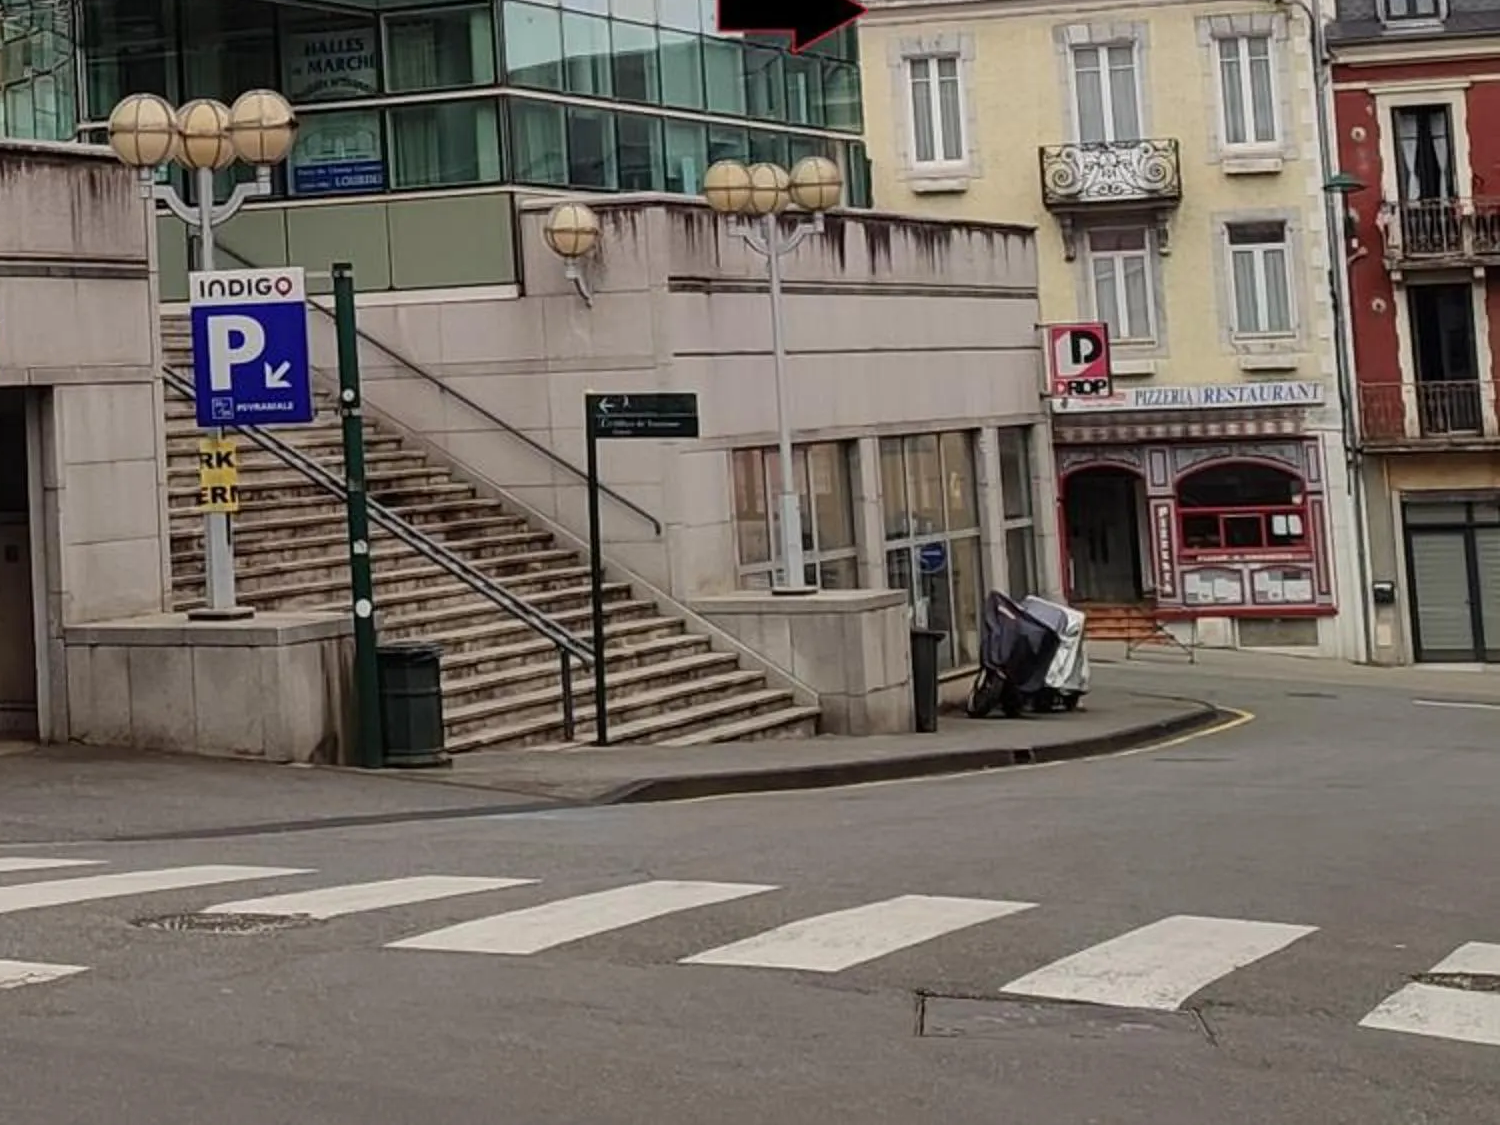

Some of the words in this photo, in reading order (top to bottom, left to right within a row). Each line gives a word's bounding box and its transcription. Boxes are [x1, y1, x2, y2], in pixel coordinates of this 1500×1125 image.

[199, 276, 293, 298] INDIGO
[207, 314, 265, 391] P
[1135, 388, 1194, 407] PIZZERIA
[1204, 382, 1320, 405] RESTAURANT
